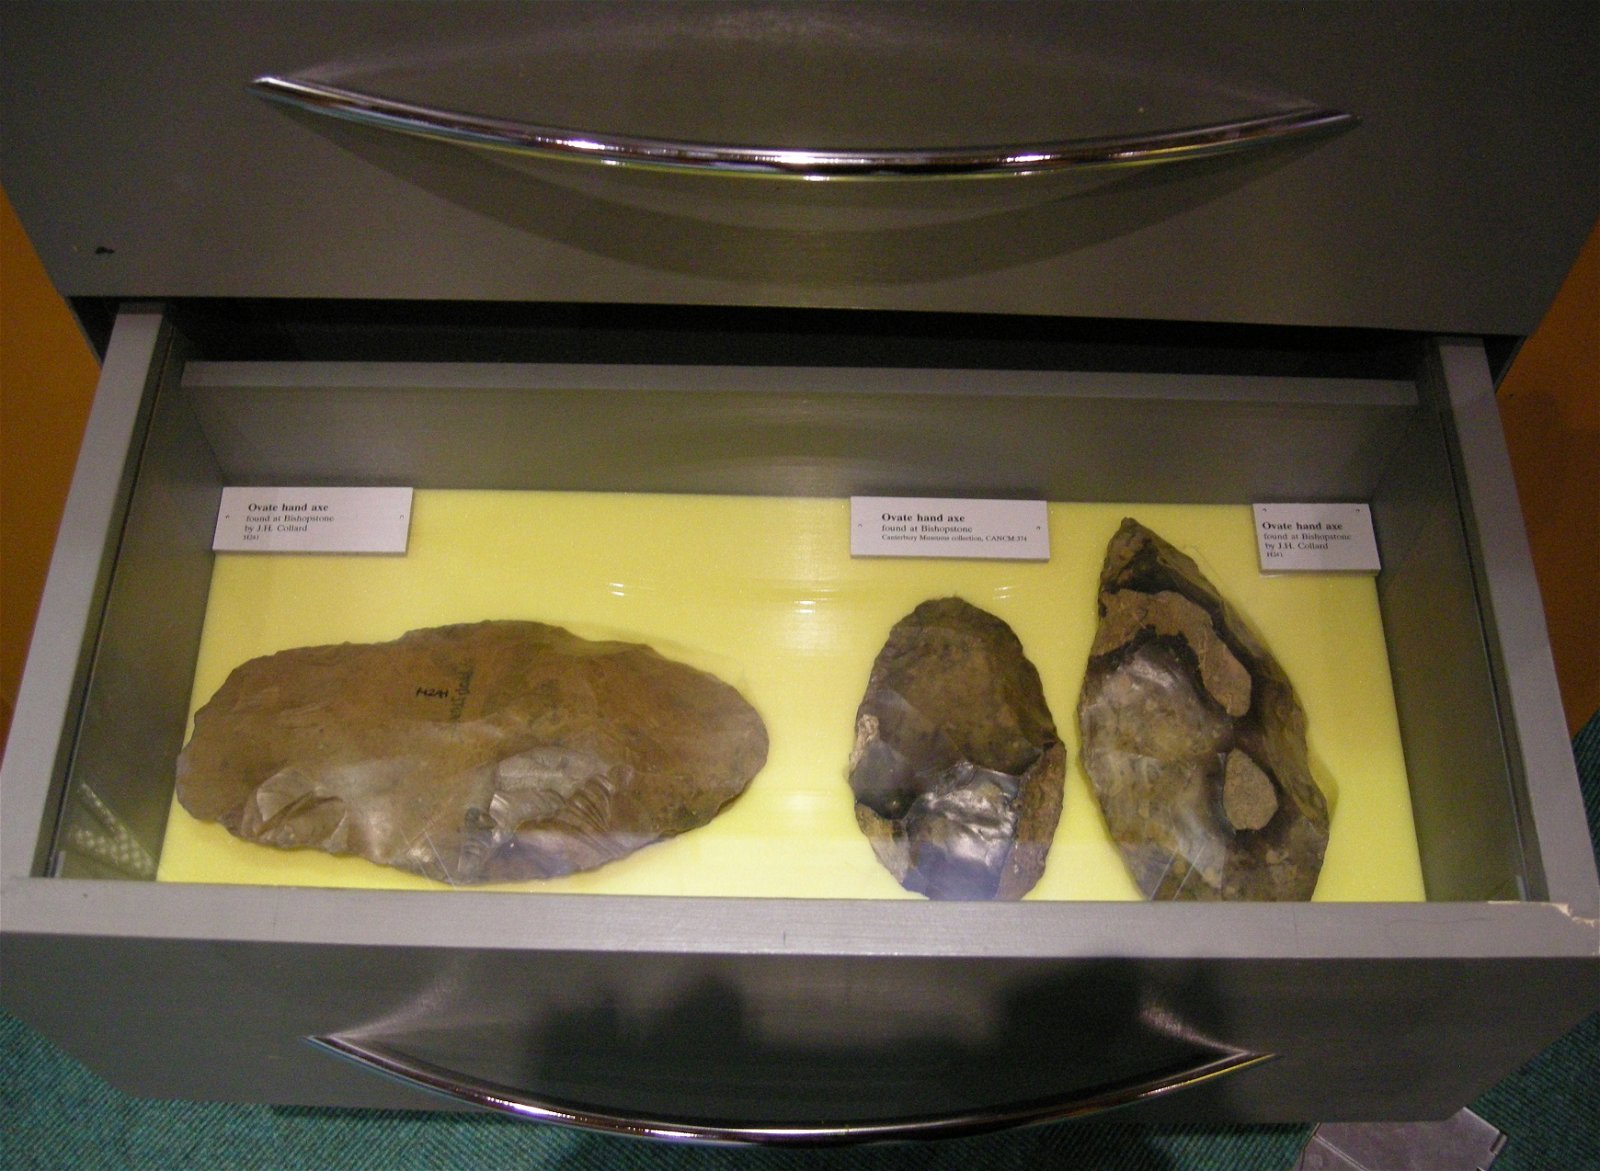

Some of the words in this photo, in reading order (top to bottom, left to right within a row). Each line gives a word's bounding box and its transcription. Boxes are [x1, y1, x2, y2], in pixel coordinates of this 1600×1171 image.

[248, 503, 278, 512] Ovate
[281, 503, 308, 512] hand
[311, 504, 329, 512] axe
[284, 515, 335, 524] Bishopstone
[881, 513, 912, 522] Ovate
[917, 513, 943, 522] hand
[244, 525, 253, 533] by
[882, 524, 906, 532] found
[921, 525, 973, 534] Bishopstone
[1262, 522, 1292, 530] Ovate
[1296, 522, 1321, 530] hand
[881, 534, 918, 542] Canterbury
[1302, 533, 1351, 542] Bishopstone
[1265, 542, 1275, 550] by
[1298, 542, 1328, 550] Collard
